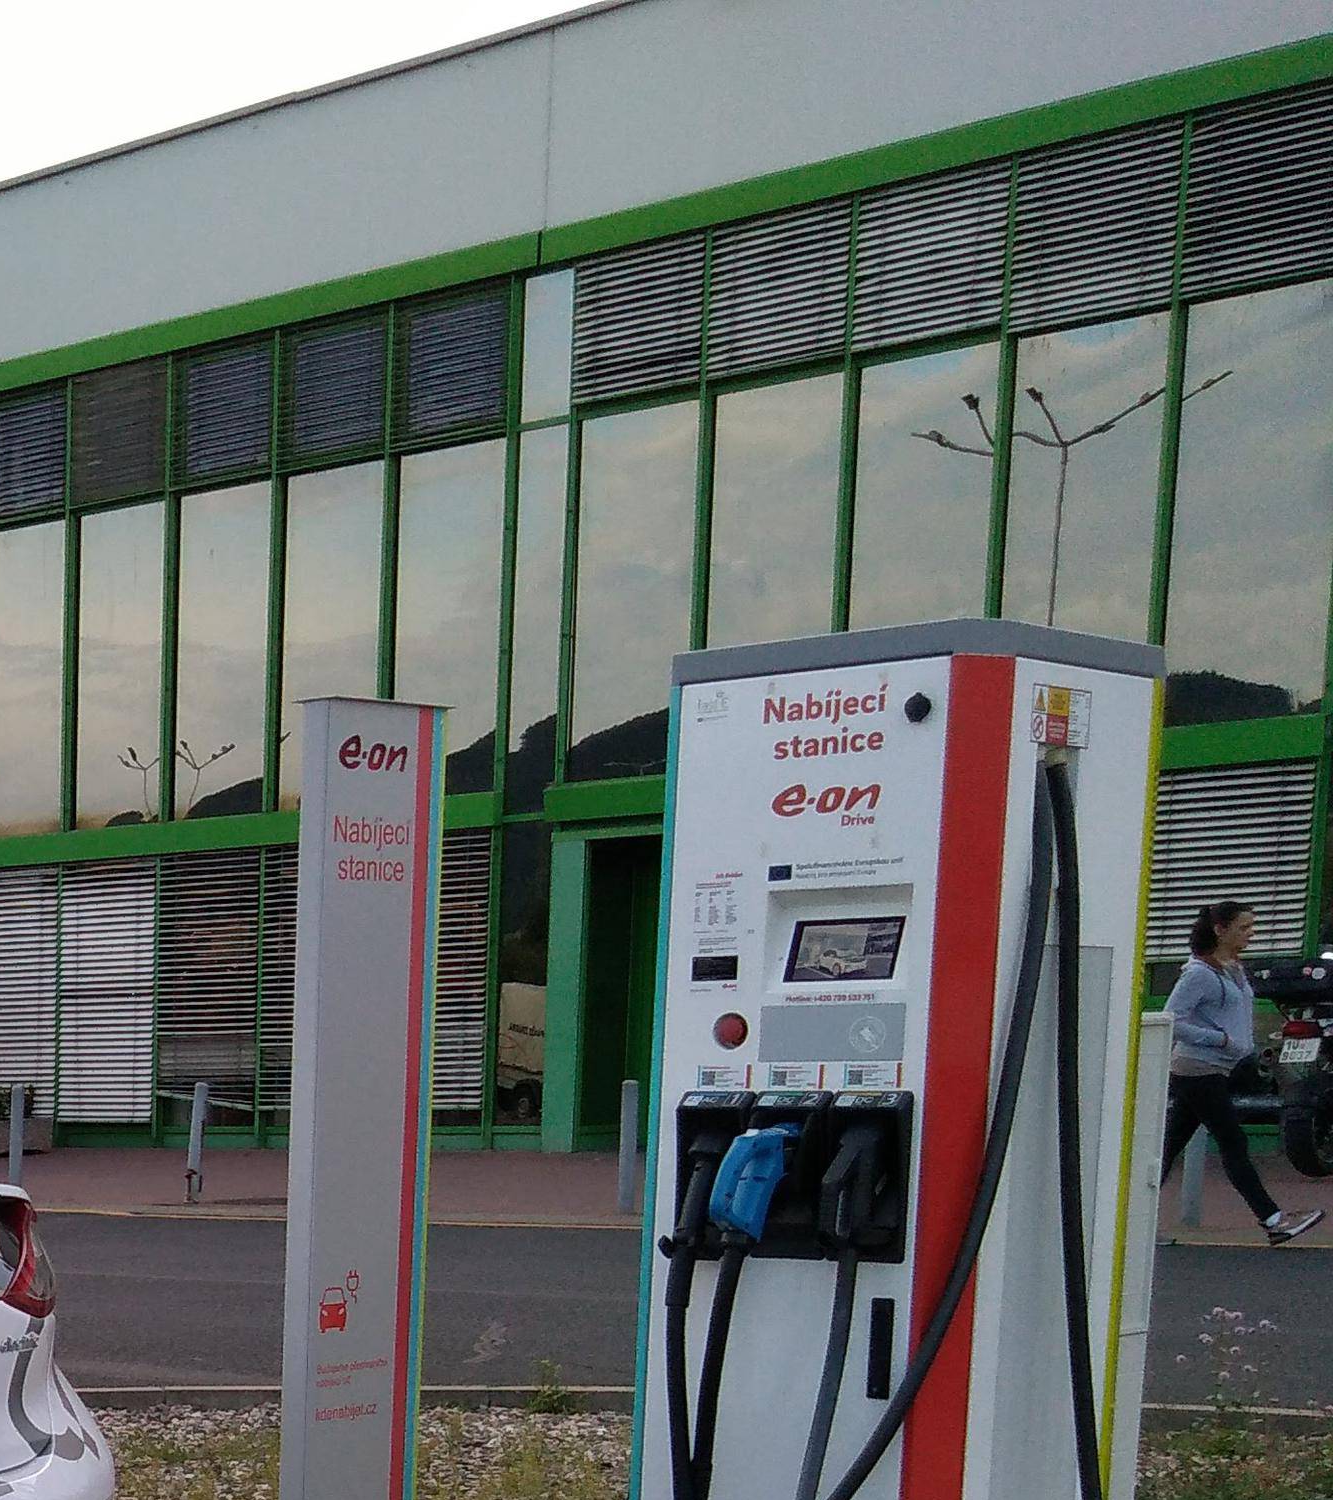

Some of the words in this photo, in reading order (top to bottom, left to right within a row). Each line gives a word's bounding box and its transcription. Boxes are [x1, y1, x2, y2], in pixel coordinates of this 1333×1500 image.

[763, 684, 888, 724] Nabíjecí
[773, 727, 884, 760] stanice
[333, 815, 411, 851] Nabíjecí
[840, 813, 875, 827] Drive
[337, 855, 404, 881] stanice
[807, 1094, 820, 1105] 2
[886, 1093, 898, 1105] 3
